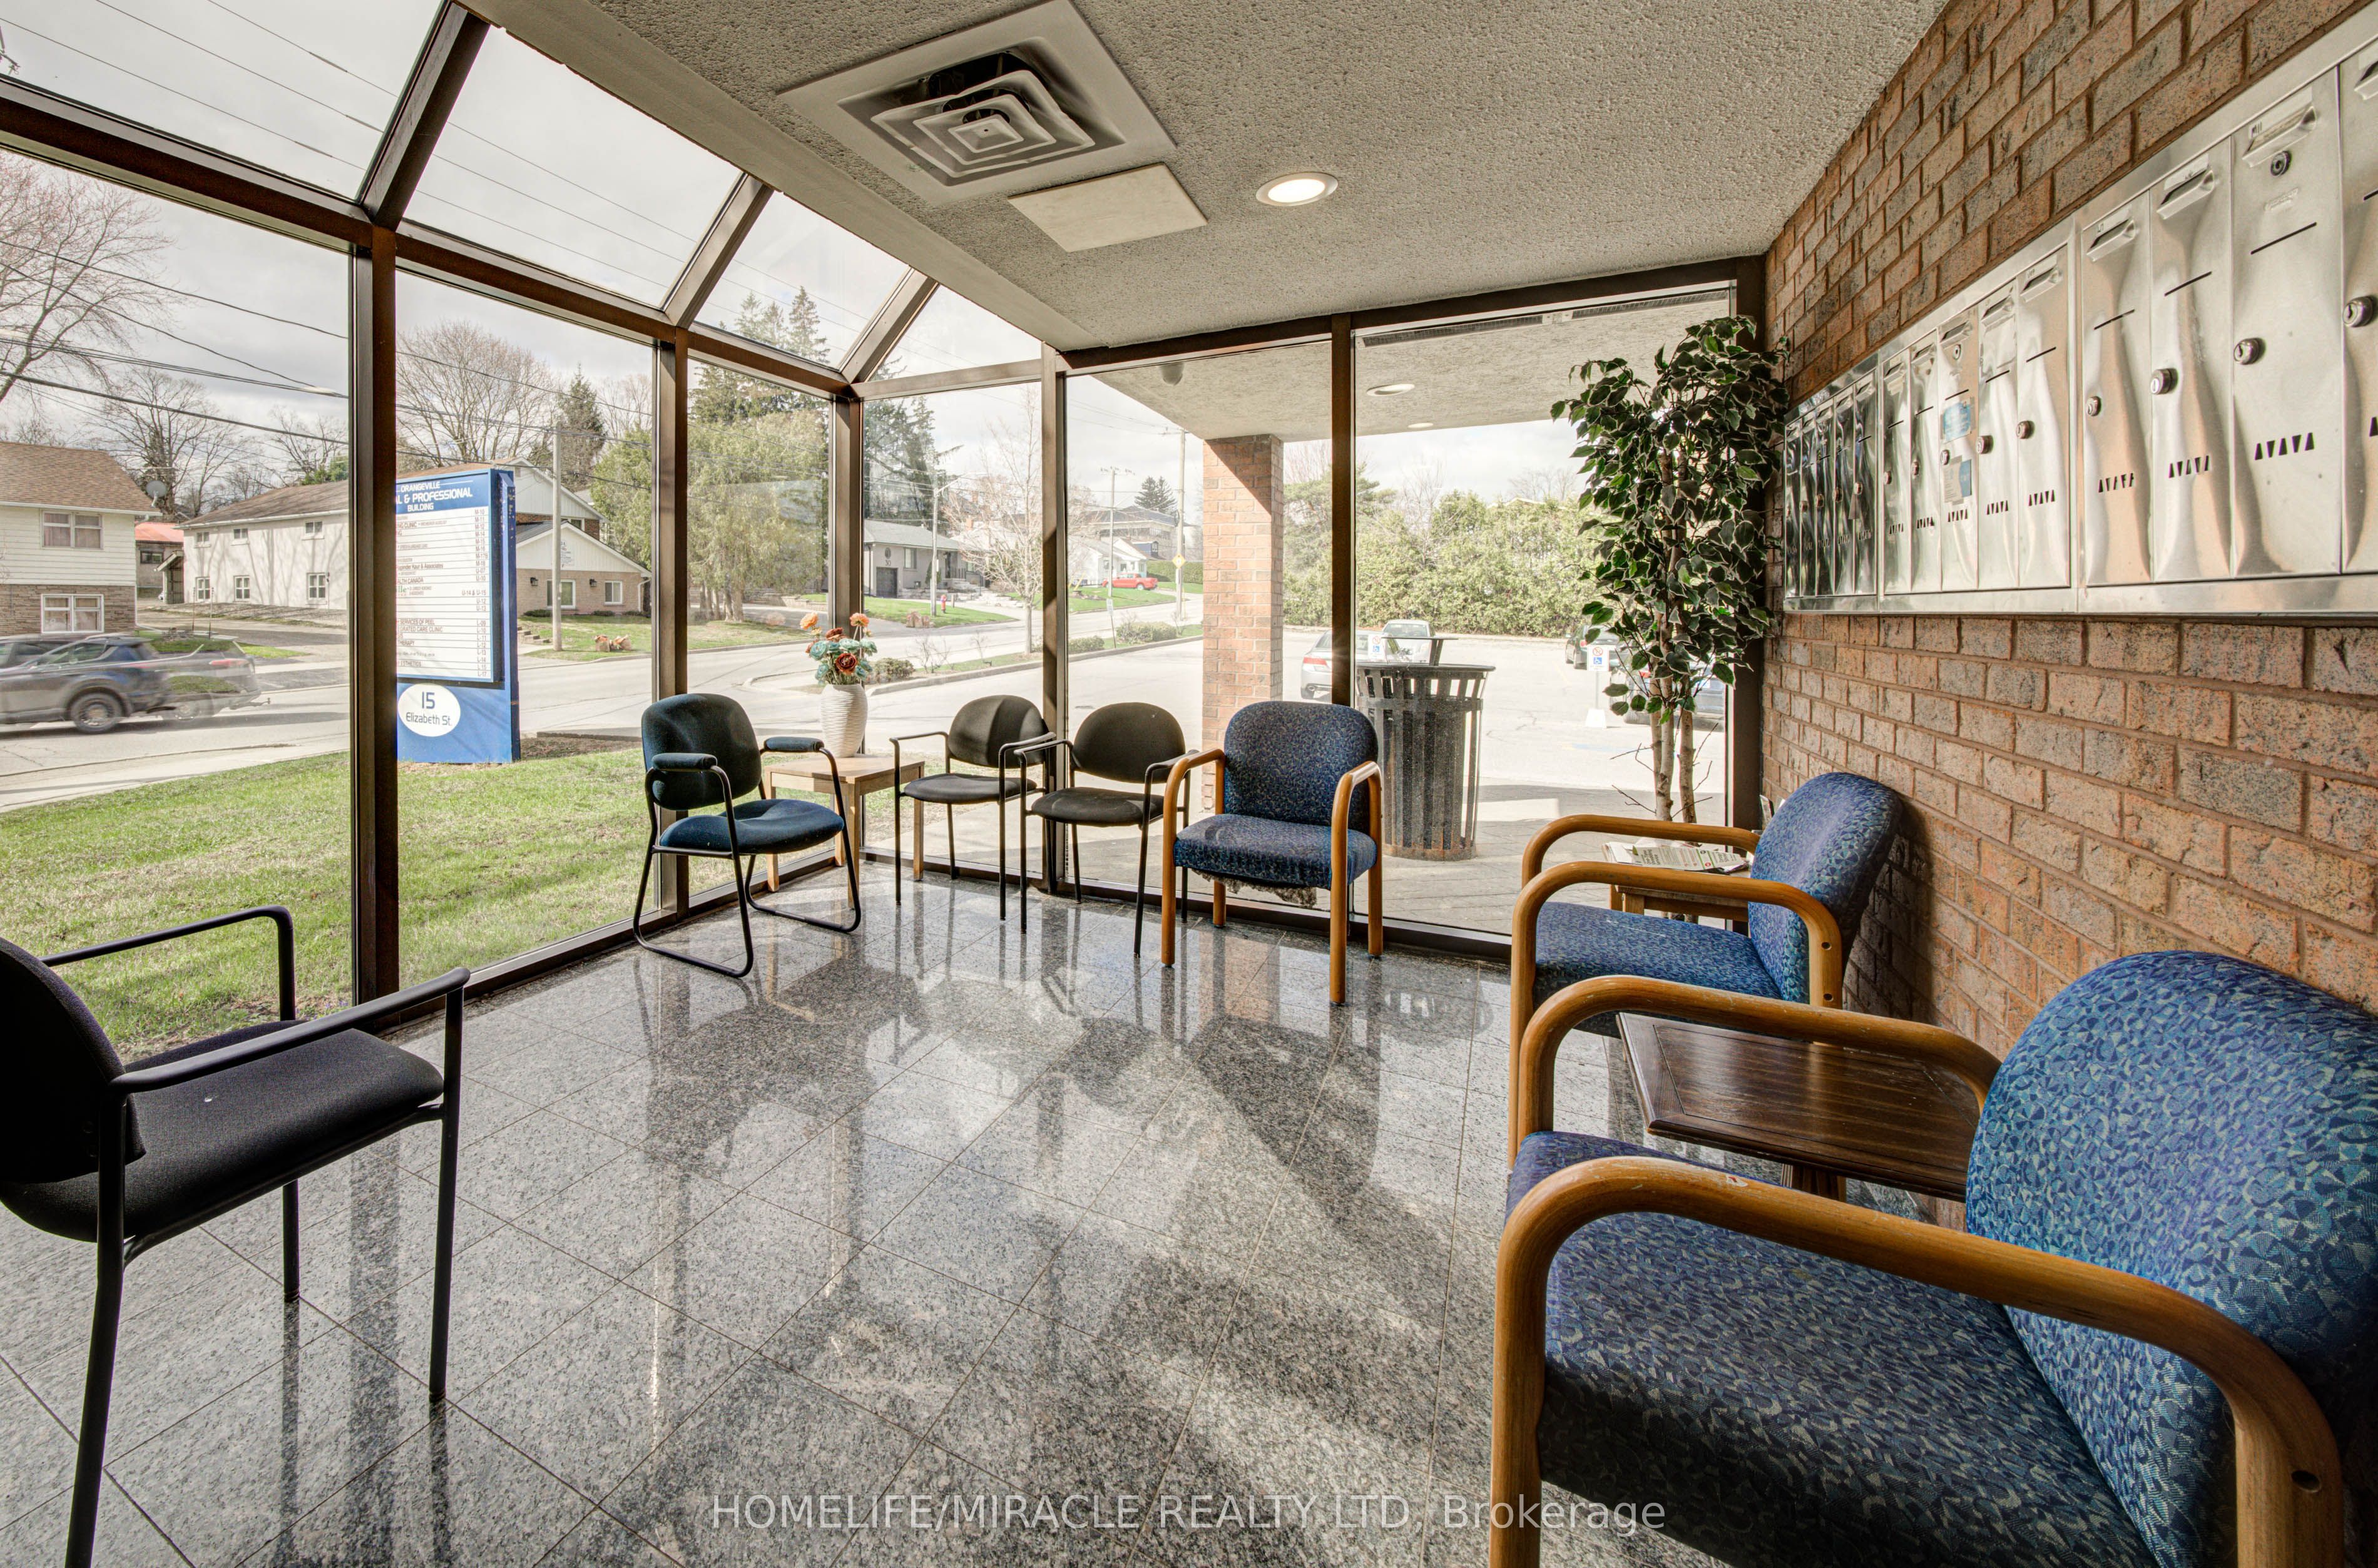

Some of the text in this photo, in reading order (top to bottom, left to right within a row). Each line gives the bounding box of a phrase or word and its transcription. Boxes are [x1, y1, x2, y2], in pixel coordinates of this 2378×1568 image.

[401, 481, 441, 492] ORANGEVILLE
[404, 495, 411, 504] &
[412, 487, 473, 502] PROFESSIONAL
[407, 502, 434, 512] BUILDING
[422, 691, 436, 709] 15
[406, 712, 440, 725] Elizabeth
